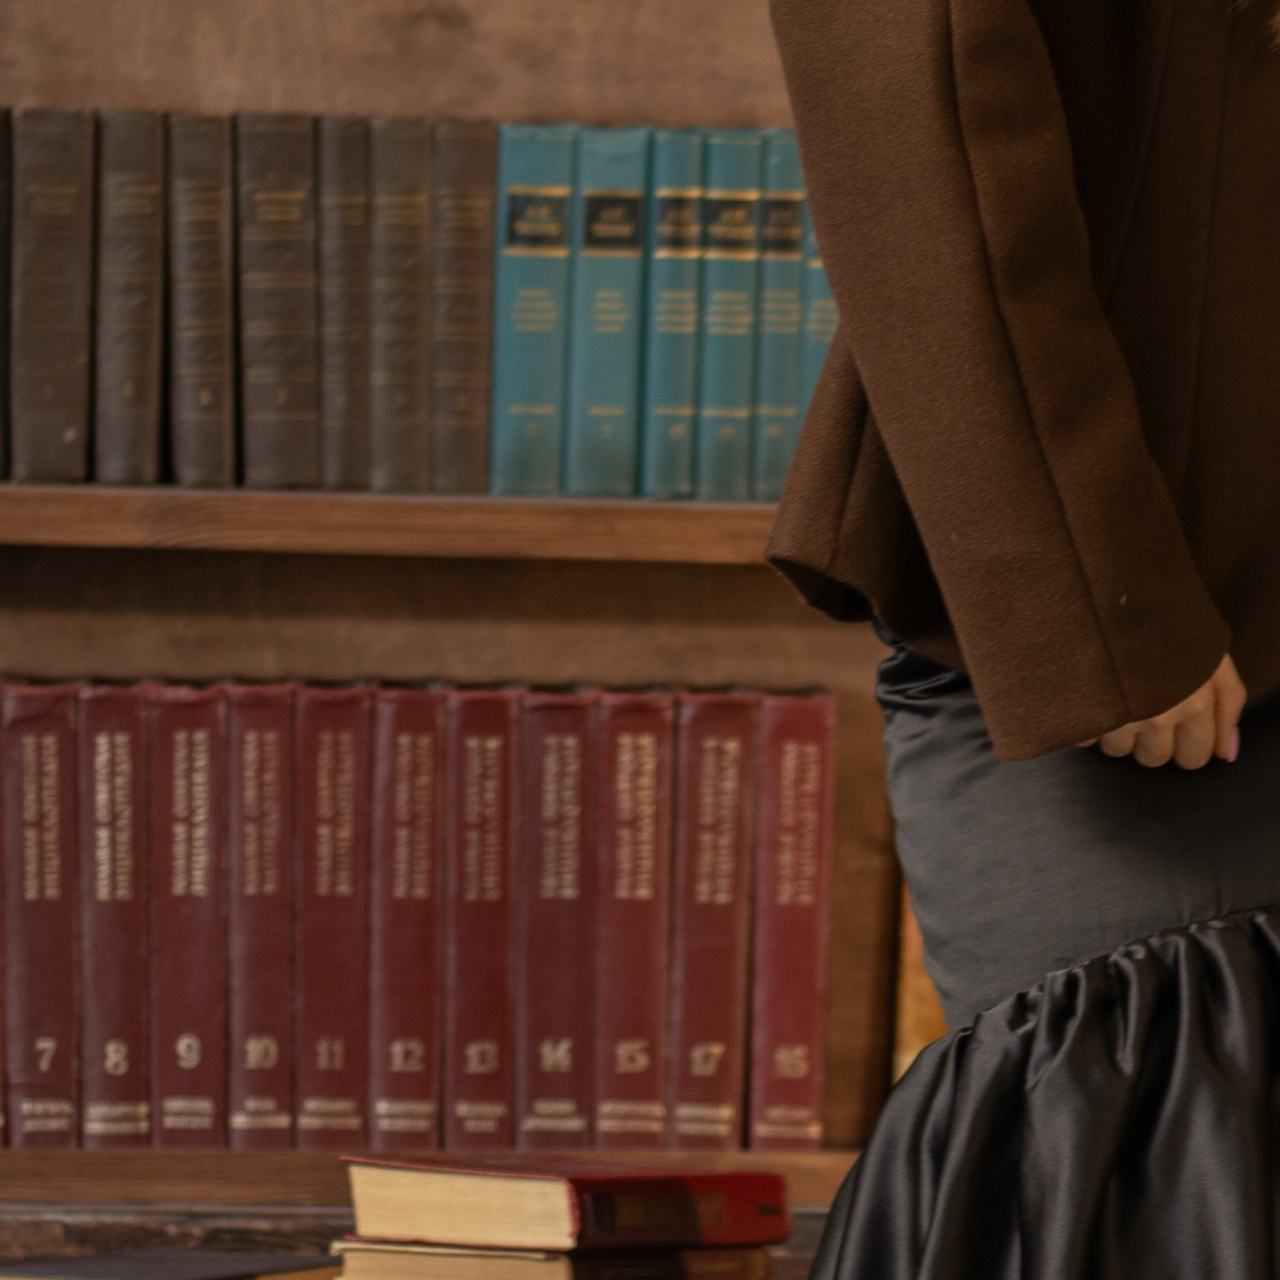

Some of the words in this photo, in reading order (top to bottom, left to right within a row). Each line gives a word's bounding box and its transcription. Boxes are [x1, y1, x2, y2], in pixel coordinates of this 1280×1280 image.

[34, 1036, 58, 1073] 7
[104, 1038, 129, 1076] 8
[175, 1032, 202, 1070] 9
[244, 1034, 279, 1071] 10
[315, 1038, 346, 1071] 11
[390, 1037, 424, 1072] 12
[464, 1038, 500, 1074] 13
[539, 1037, 573, 1072] 14
[614, 1038, 651, 1074] 15
[690, 1041, 727, 1077] 17
